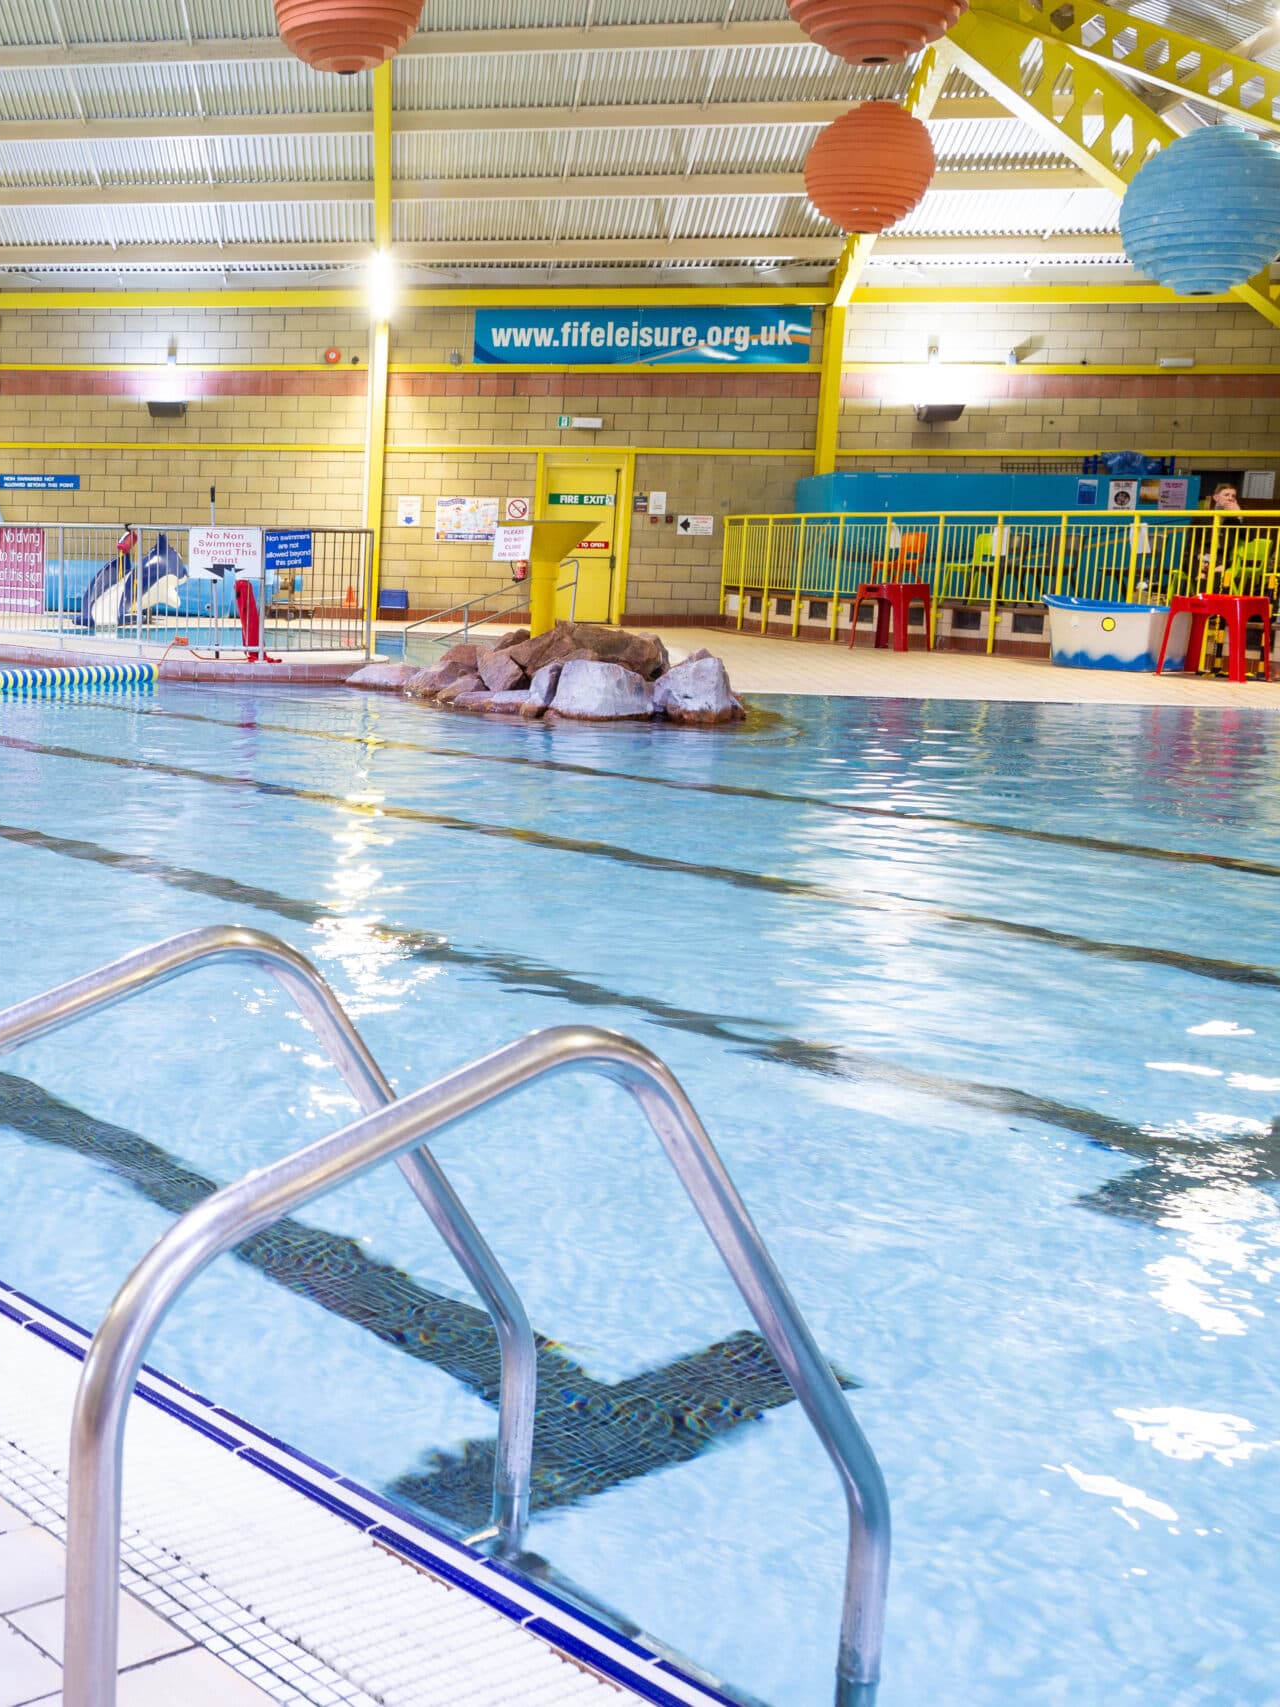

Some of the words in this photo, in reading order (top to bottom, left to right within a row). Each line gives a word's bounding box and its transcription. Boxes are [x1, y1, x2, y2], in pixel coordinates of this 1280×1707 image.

[491, 320, 793, 352] www.fifeleisure.org.uk
[559, 494, 579, 504] FIRE
[583, 494, 606, 505] EXIT
[2, 530, 15, 544] No
[16, 529, 41, 547] dvng
[206, 532, 220, 540] No
[223, 532, 244, 540] Non
[280, 533, 311, 541] swimmers
[198, 540, 252, 549] Swimmers
[193, 547, 232, 557] Beyond
[235, 548, 257, 557] This
[266, 551, 289, 559] allowed
[290, 550, 312, 558] beyond
[210, 556, 238, 564] Point
[287, 558, 302, 566] point
